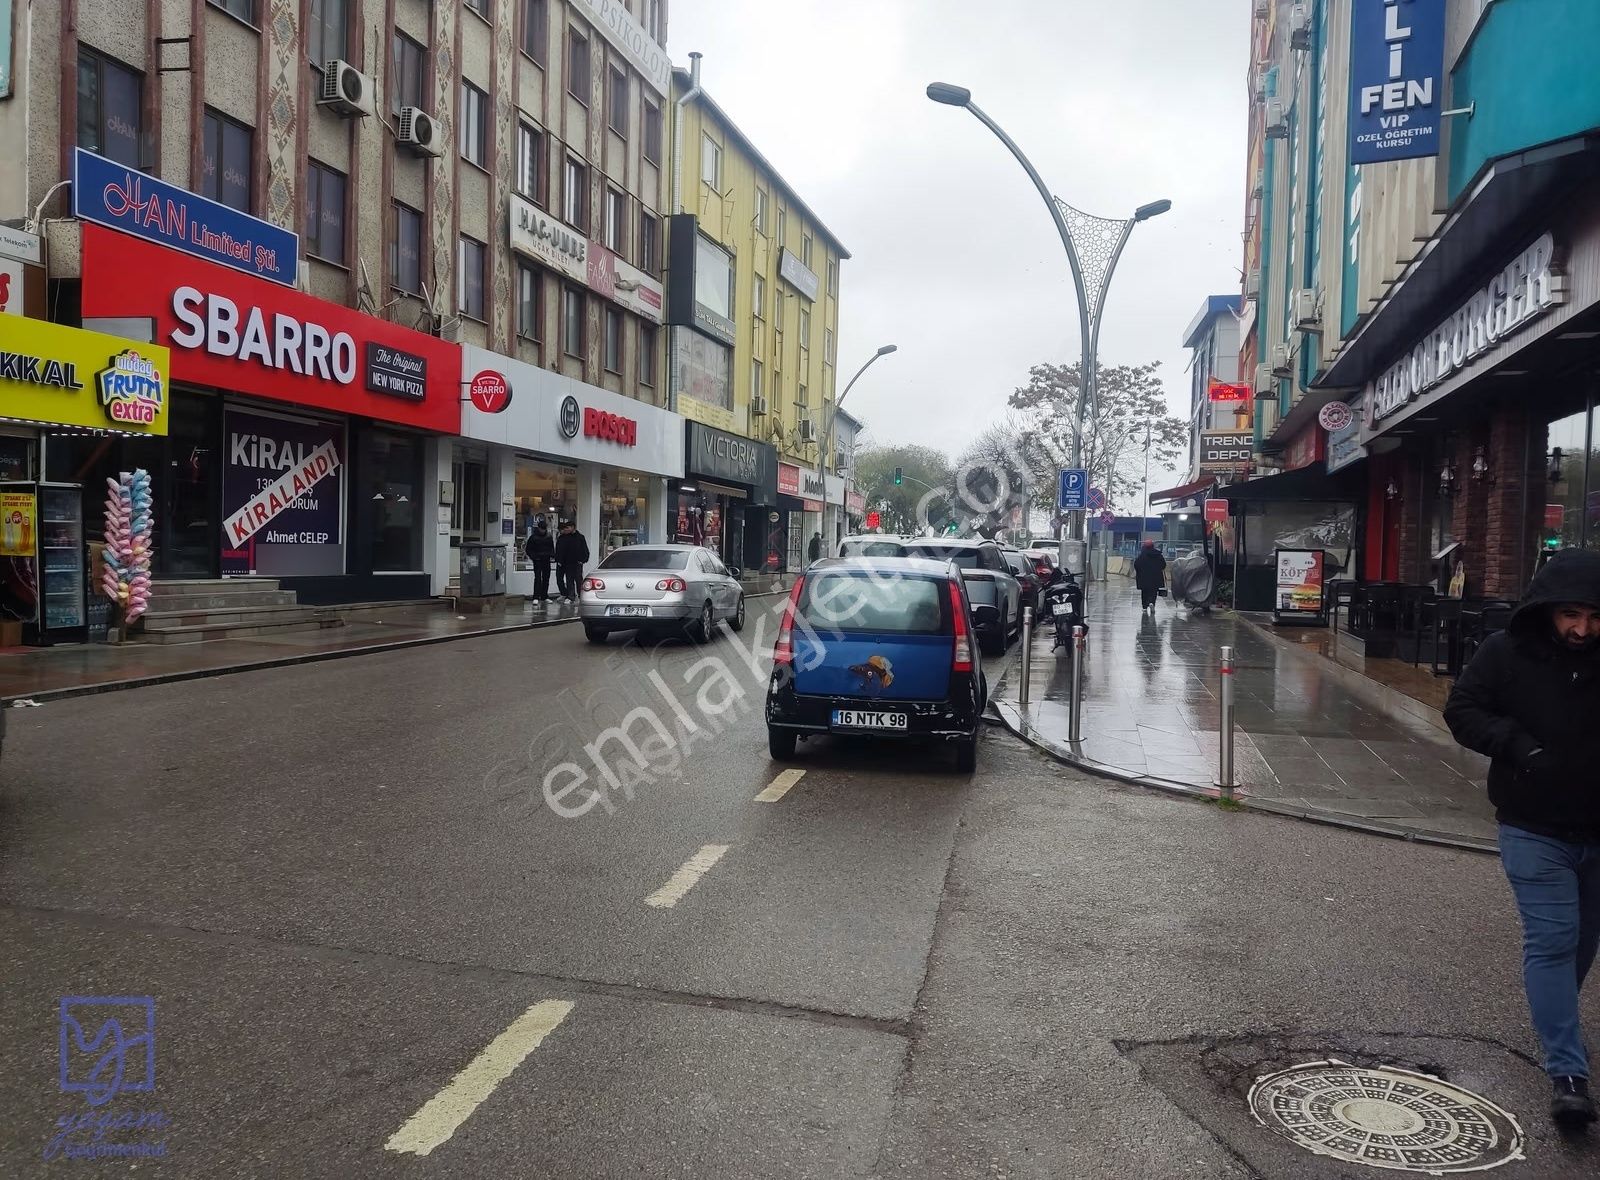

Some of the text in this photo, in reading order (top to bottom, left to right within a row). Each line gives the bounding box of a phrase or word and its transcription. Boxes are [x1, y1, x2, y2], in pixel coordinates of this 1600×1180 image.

[1361, 77, 1433, 113] FEN
[1380, 114, 1410, 129] VIP
[1376, 138, 1412, 148] KURSU
[191, 221, 251, 263] Limited
[171, 286, 357, 384] SBARRO
[376, 349, 423, 372] The Original
[373, 372, 424, 396] NEW YORK PIZZA
[472, 386, 505, 394] SBARRO
[113, 401, 153, 422] extra
[584, 407, 637, 447] BOSCH
[704, 432, 757, 466] VICTORIA
[1069, 474, 1078, 487] P
[232, 449, 335, 541] KİRALANDI
[266, 531, 328, 543] Ahmet CELEP
[839, 711, 852, 724] 16
[857, 712, 885, 726] NTK
[889, 713, 905, 727] 98
